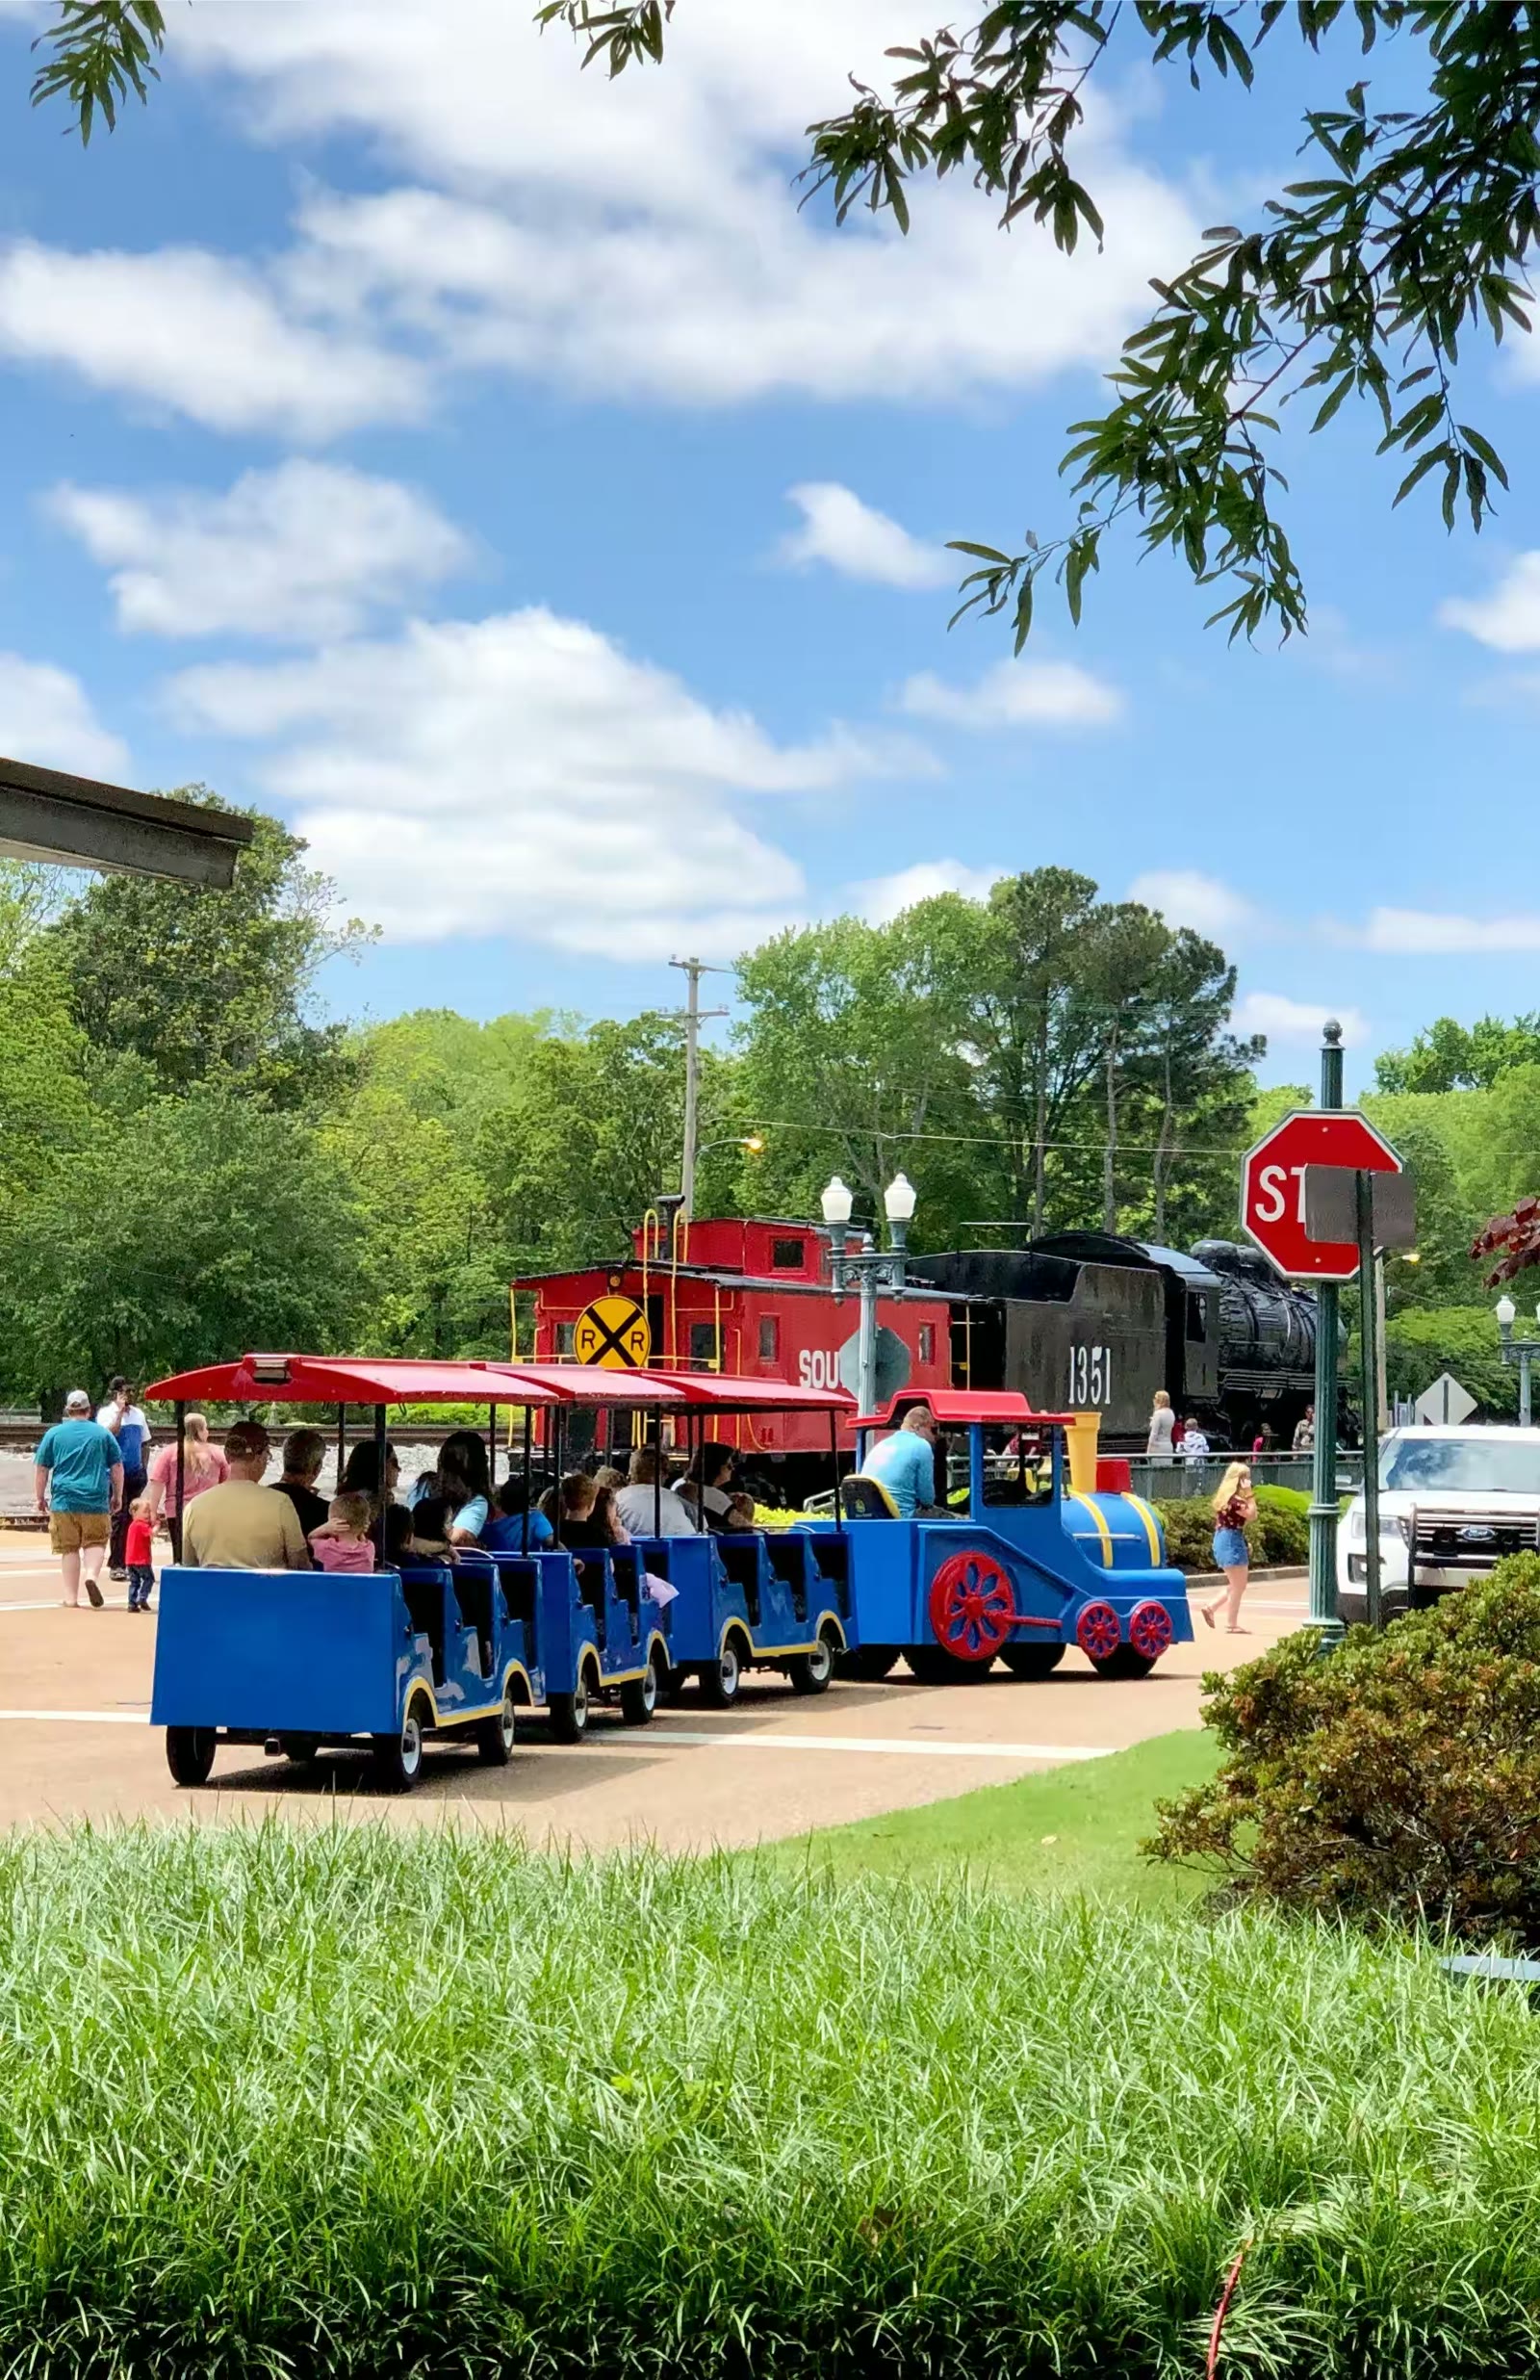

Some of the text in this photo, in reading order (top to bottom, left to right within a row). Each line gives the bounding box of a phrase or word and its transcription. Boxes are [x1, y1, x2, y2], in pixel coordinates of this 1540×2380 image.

[1255, 1165, 1306, 1223] ST
[581, 1329, 645, 1352] R R
[799, 1349, 841, 1389] SOU
[1068, 1346, 1111, 1405] 1351
